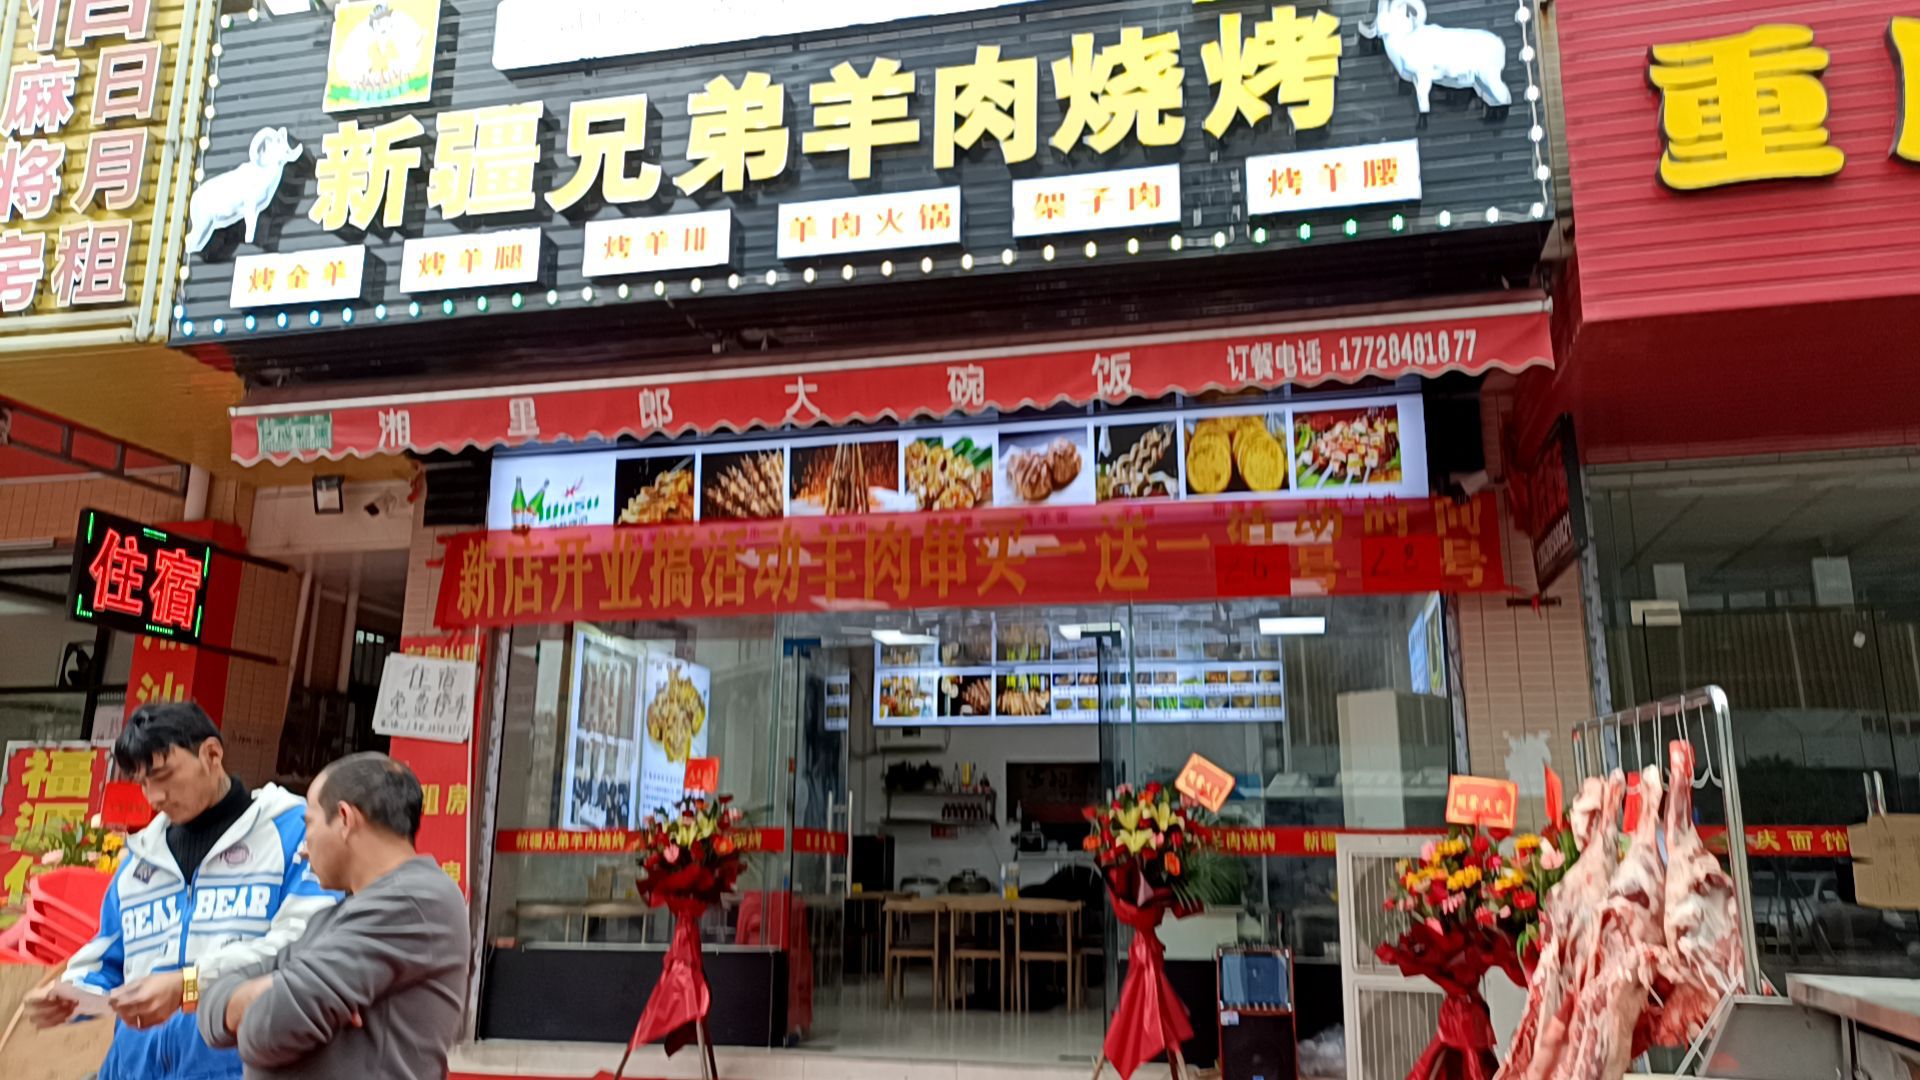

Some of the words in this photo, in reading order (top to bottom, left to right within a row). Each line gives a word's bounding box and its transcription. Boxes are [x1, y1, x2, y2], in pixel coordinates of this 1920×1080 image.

[308, 5, 1342, 231] 新疆兄弟羊肉烧烤
[0, 54, 80, 312] 麻将房
[789, 202, 952, 243] 羊肉火锅
[1034, 182, 1161, 220] 架子肉
[377, 351, 1133, 449] 湘里郎大碗饭
[89, 527, 203, 631] 住宿
[192, 885, 271, 921] BEAR
